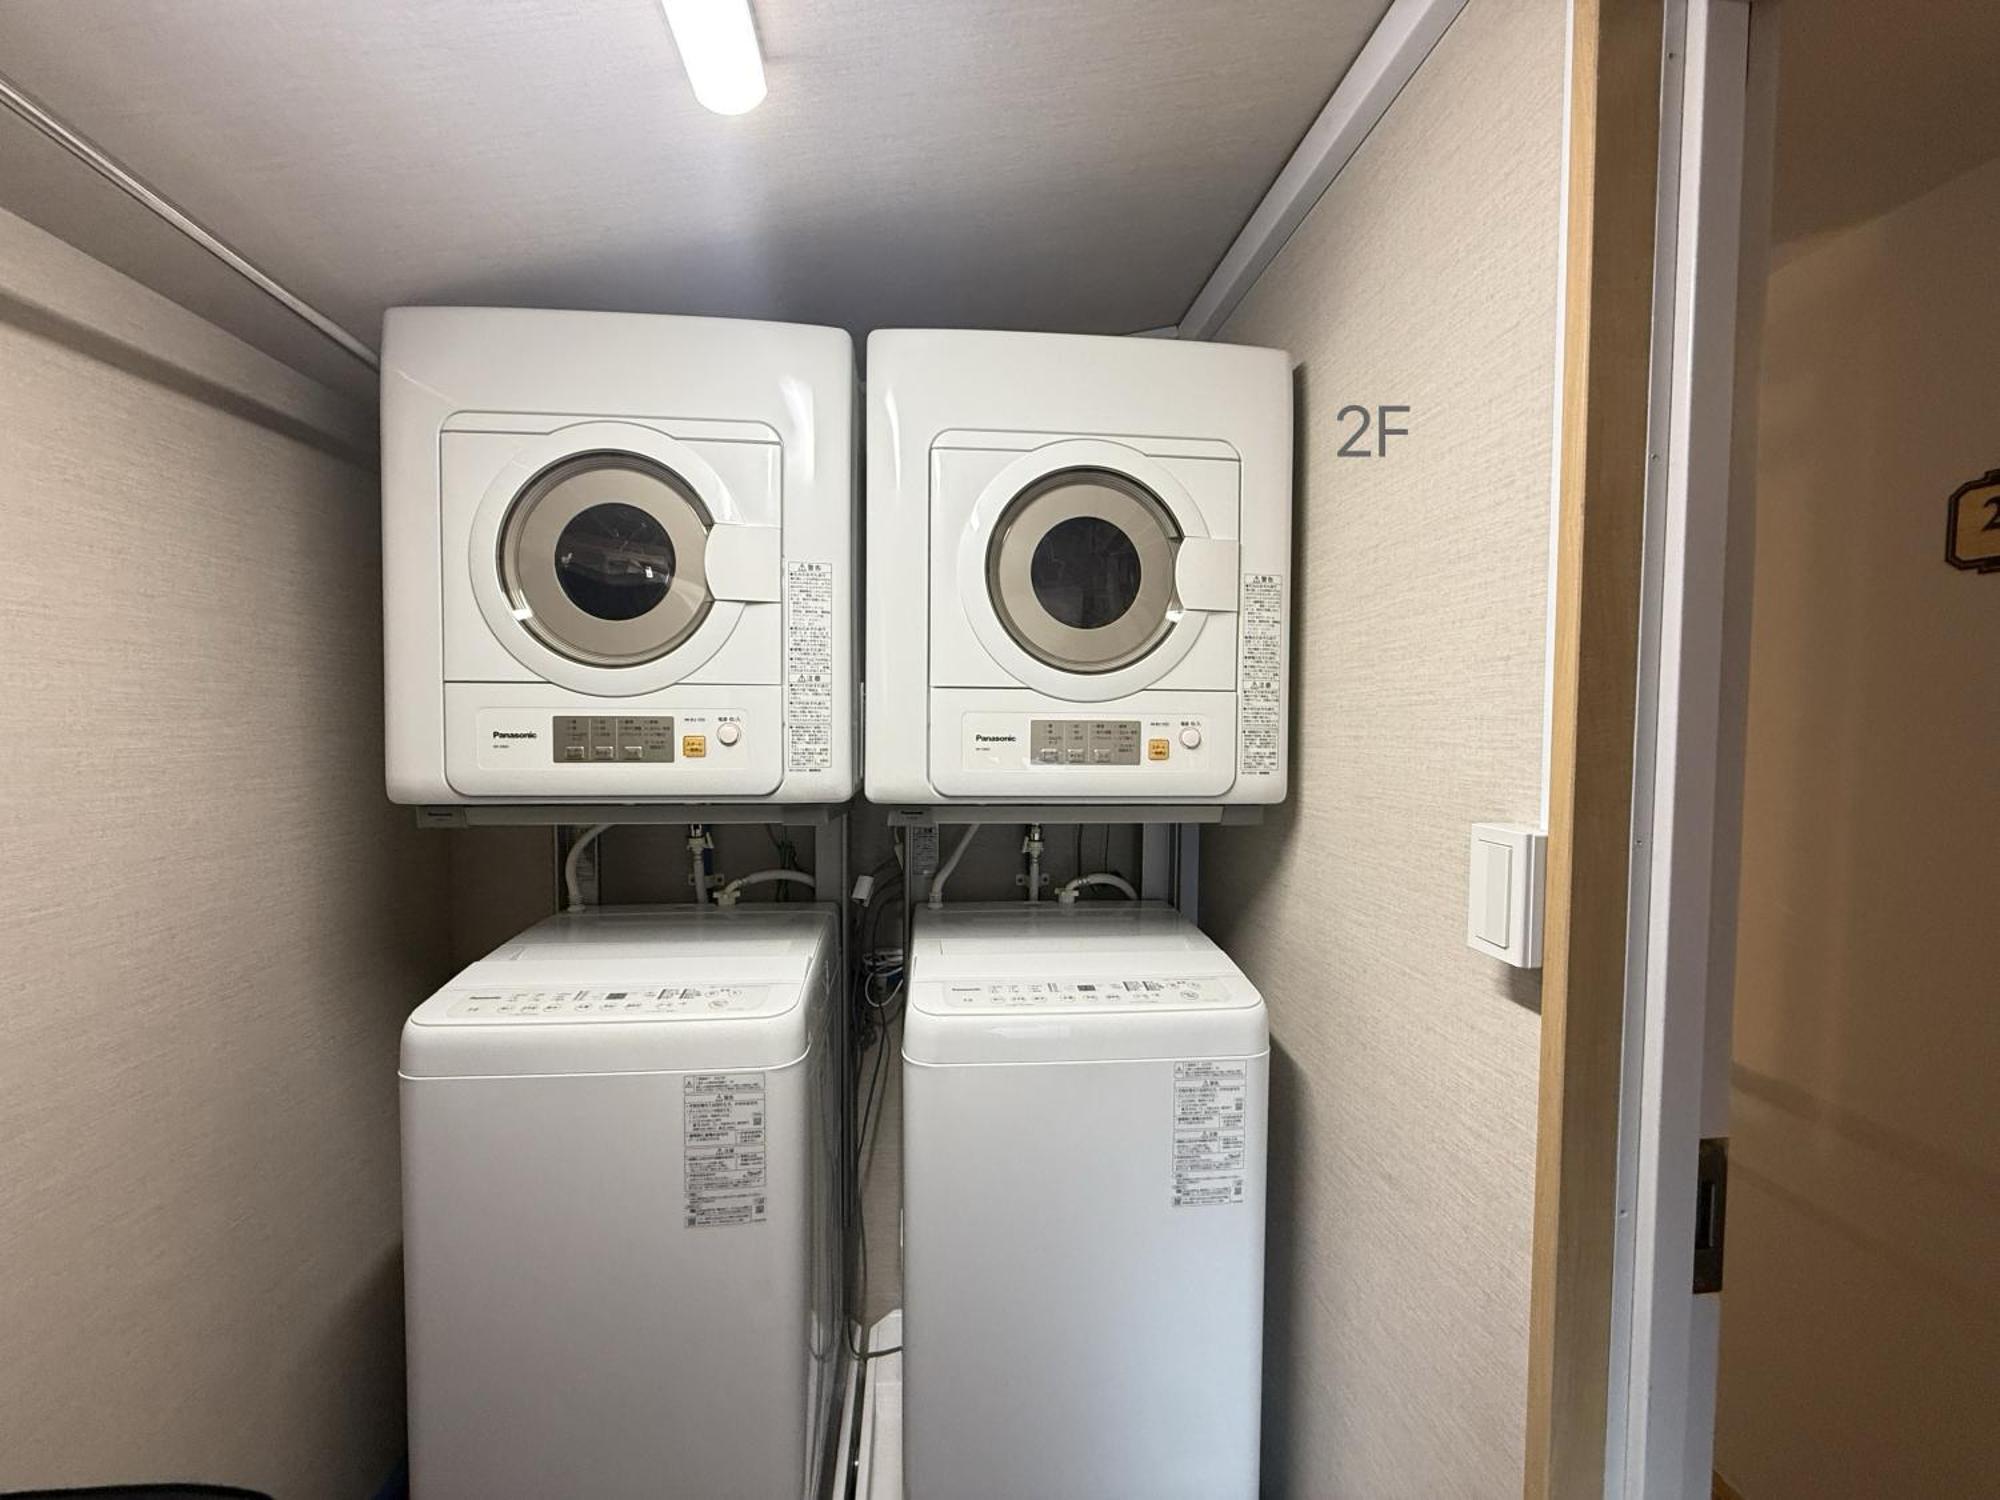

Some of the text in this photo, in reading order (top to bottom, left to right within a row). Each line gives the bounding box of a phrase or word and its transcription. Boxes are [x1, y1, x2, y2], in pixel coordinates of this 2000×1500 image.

[1336, 404, 1411, 458] 2F
[492, 731, 537, 739] Panasonic
[975, 733, 1017, 742] Panasonic
